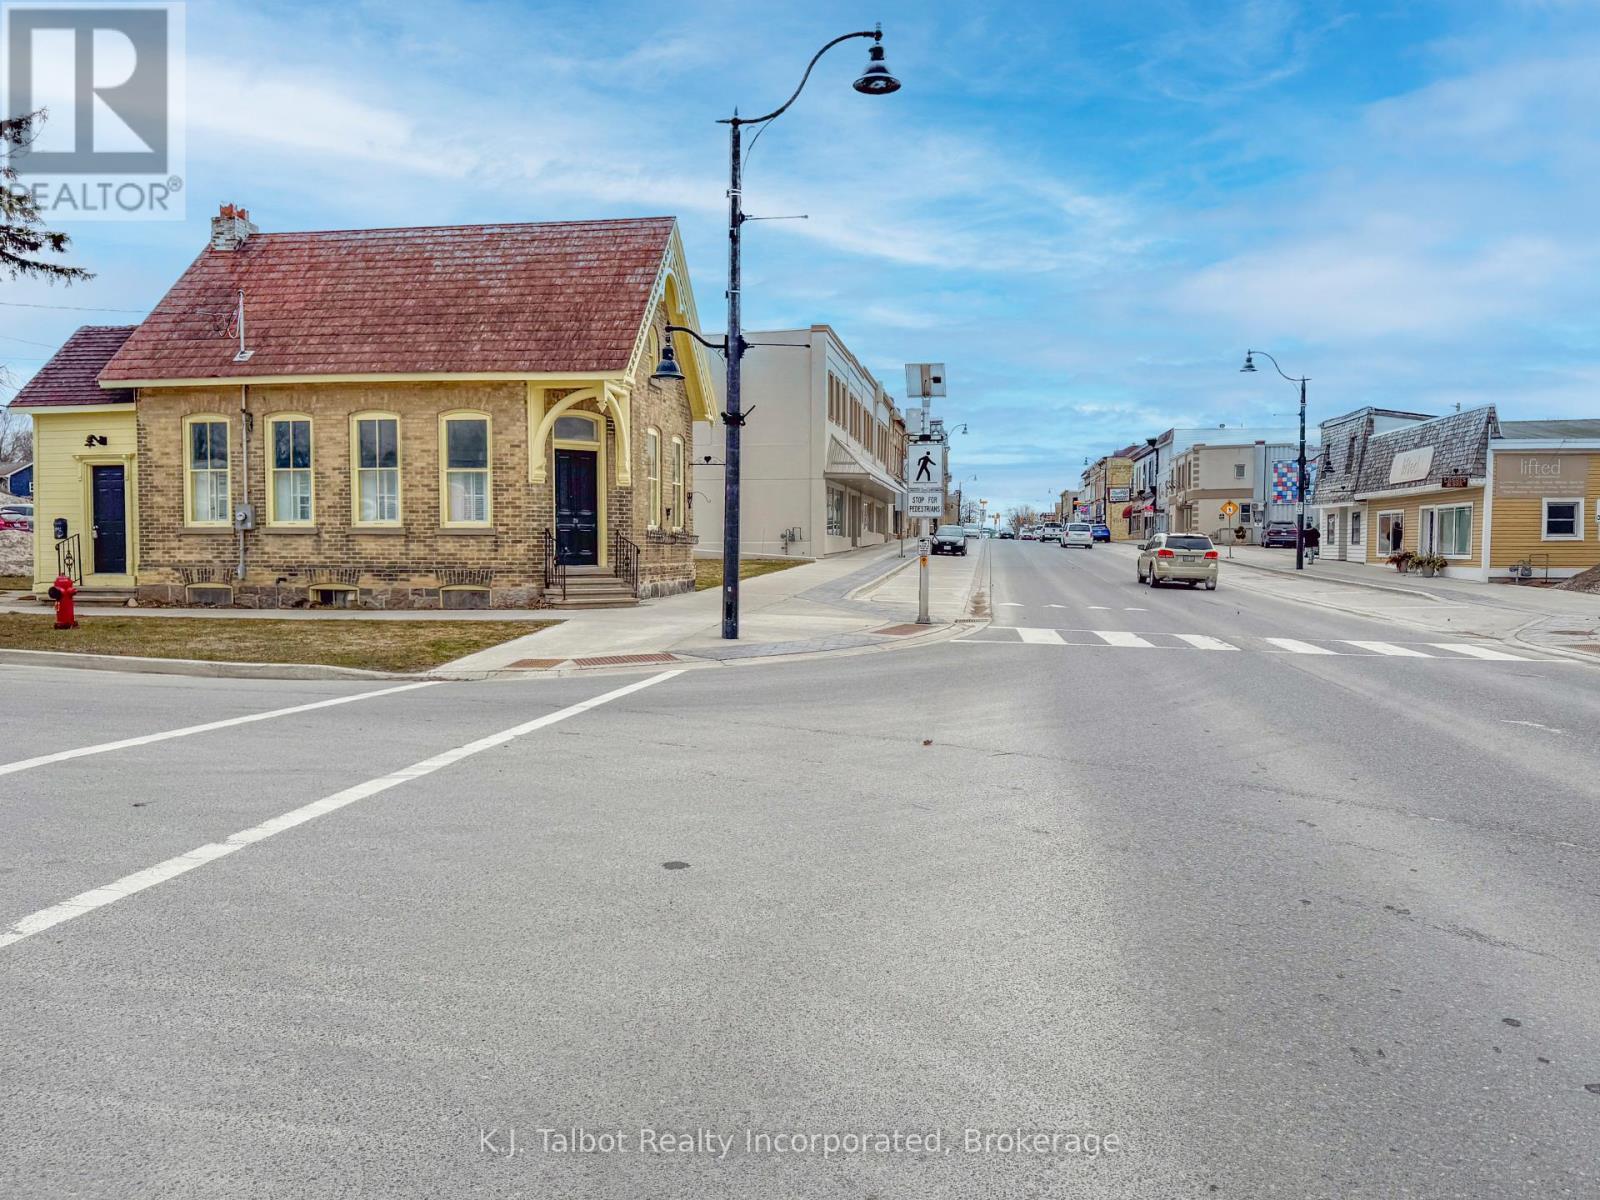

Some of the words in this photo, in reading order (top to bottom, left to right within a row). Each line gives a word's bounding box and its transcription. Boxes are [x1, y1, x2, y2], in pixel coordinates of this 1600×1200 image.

[1520, 457, 1561, 475] lifted
[912, 496, 925, 504] STOP
[928, 496, 938, 504] FOR
[909, 505, 941, 513] PEDESTRIANS
